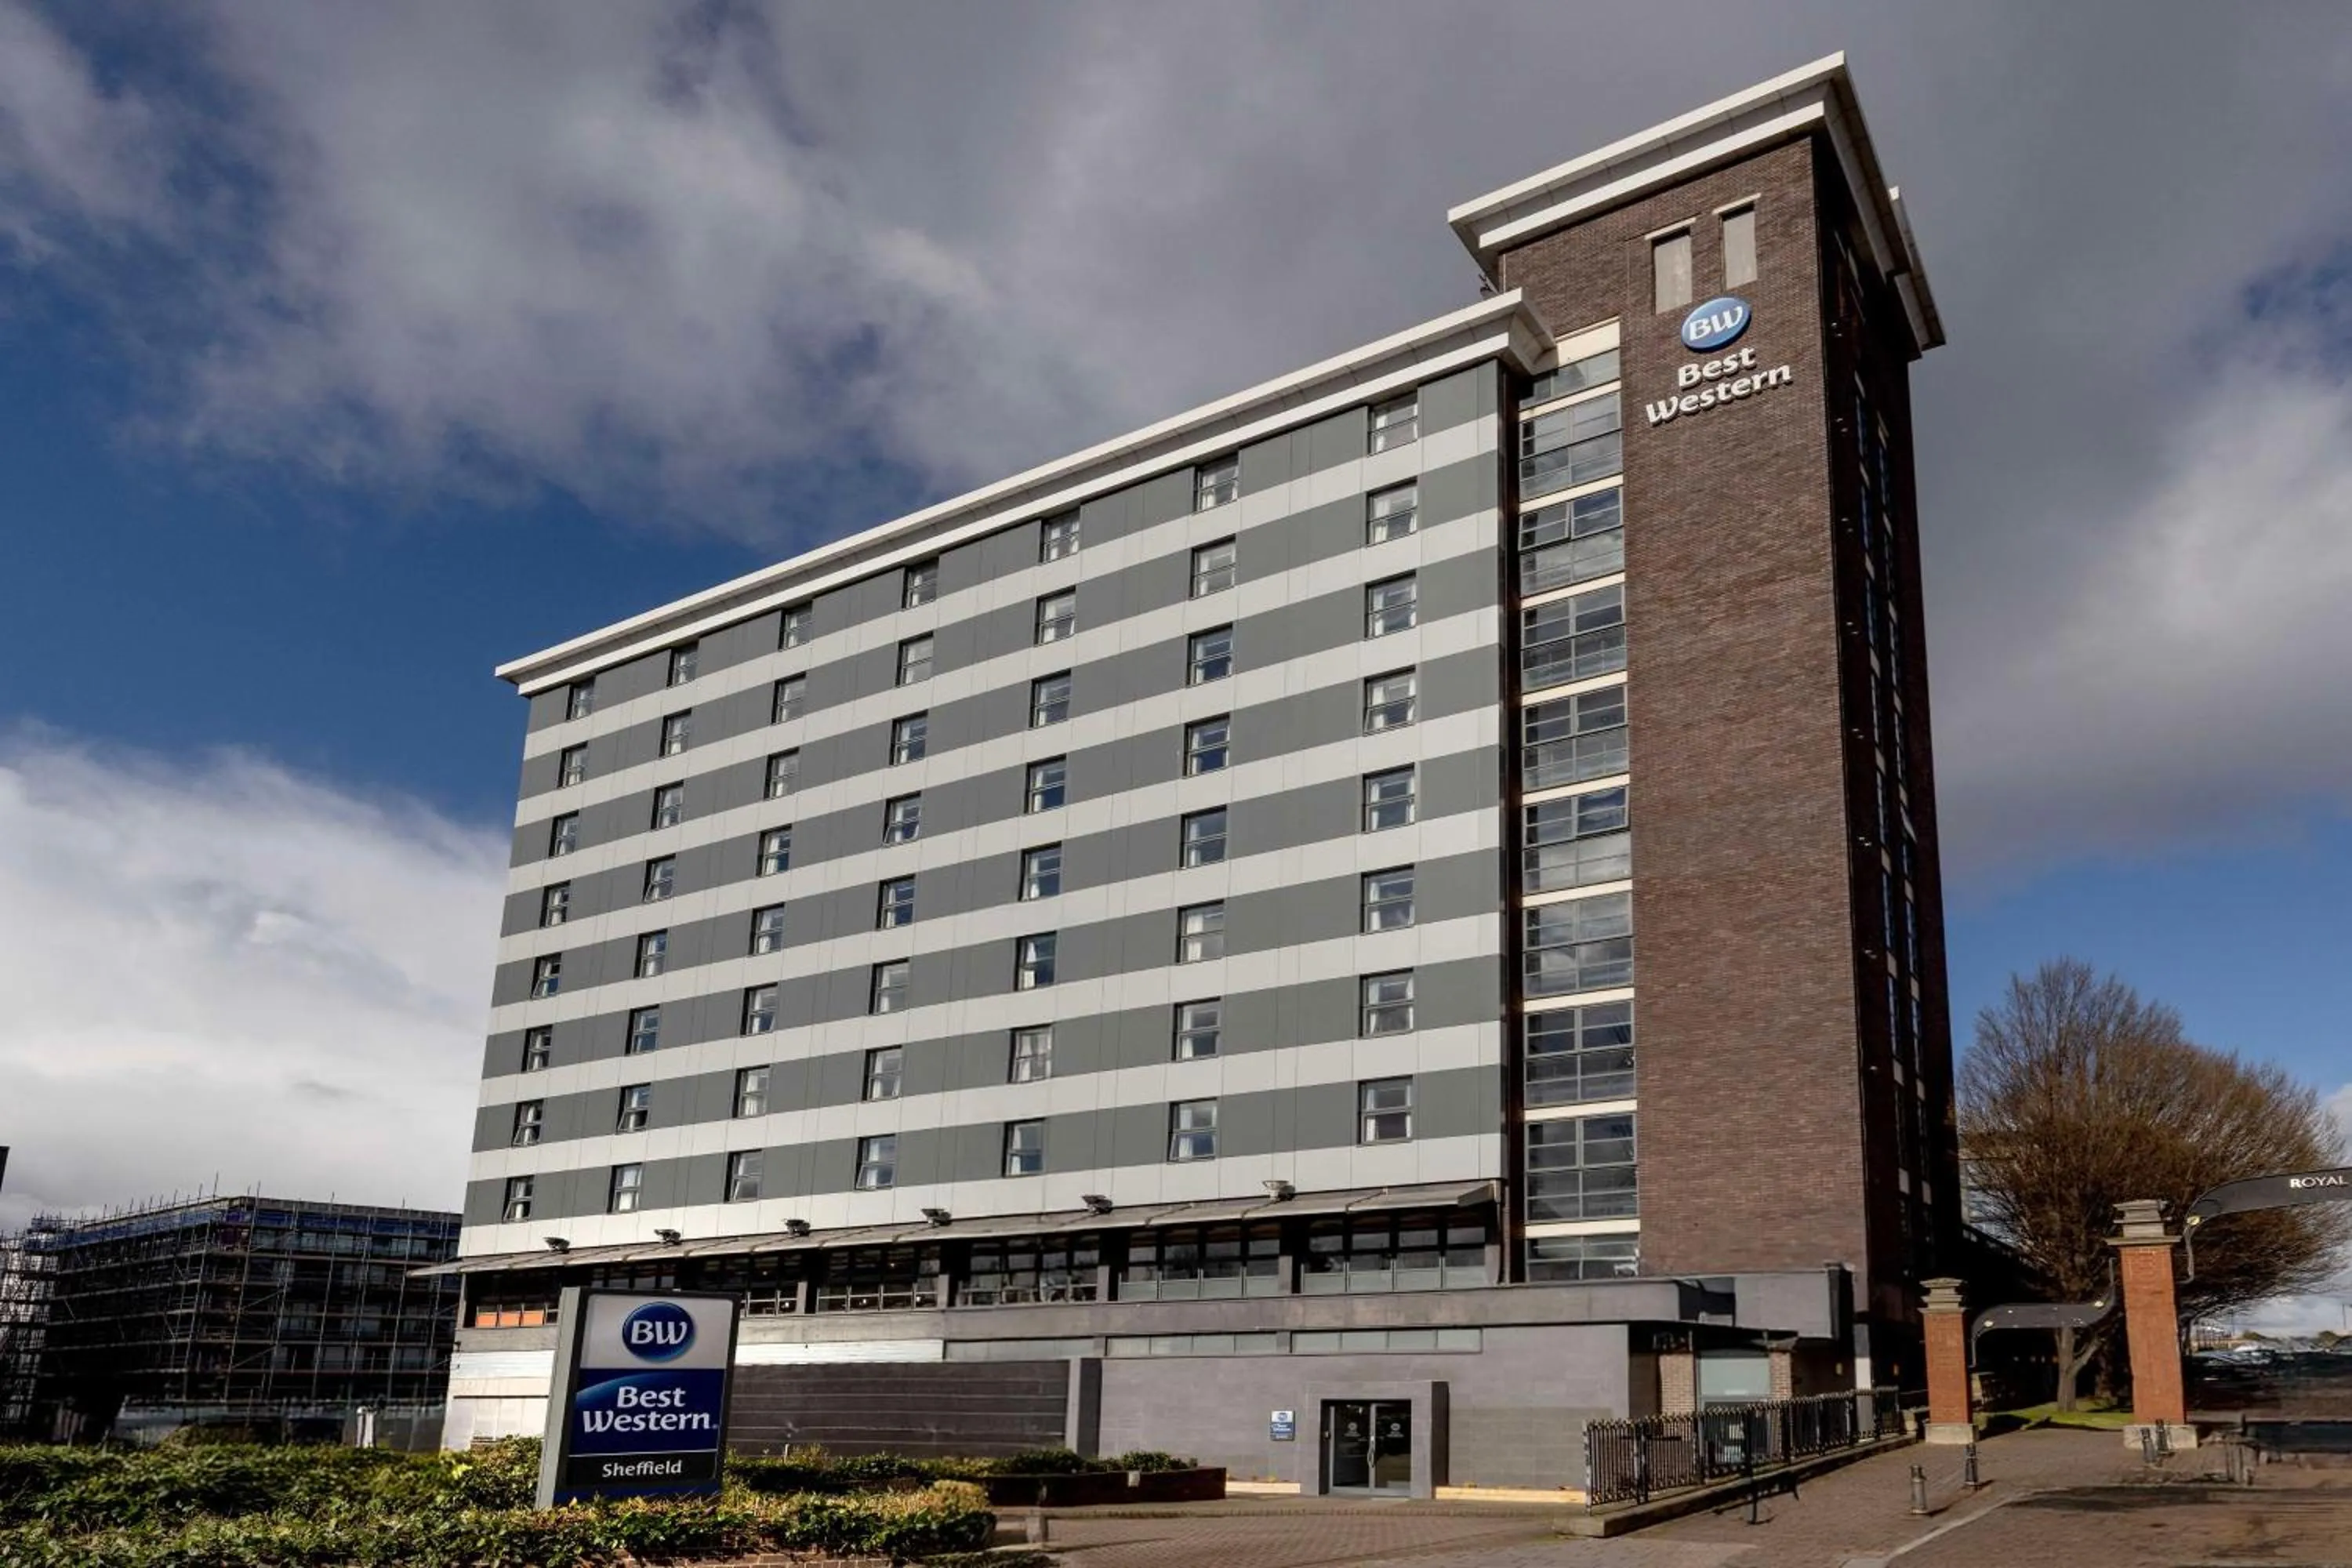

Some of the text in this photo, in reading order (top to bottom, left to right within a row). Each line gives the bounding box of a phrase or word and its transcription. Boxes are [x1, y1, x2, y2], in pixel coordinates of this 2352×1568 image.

[1689, 306, 1743, 341] BW
[1678, 347, 1755, 387] Best
[1646, 365, 1791, 423] Western
[2289, 1175, 2348, 1189] ROYAL
[630, 1319, 688, 1345] BW
[616, 1385, 687, 1408] Best
[601, 1460, 682, 1478] Sheffield
